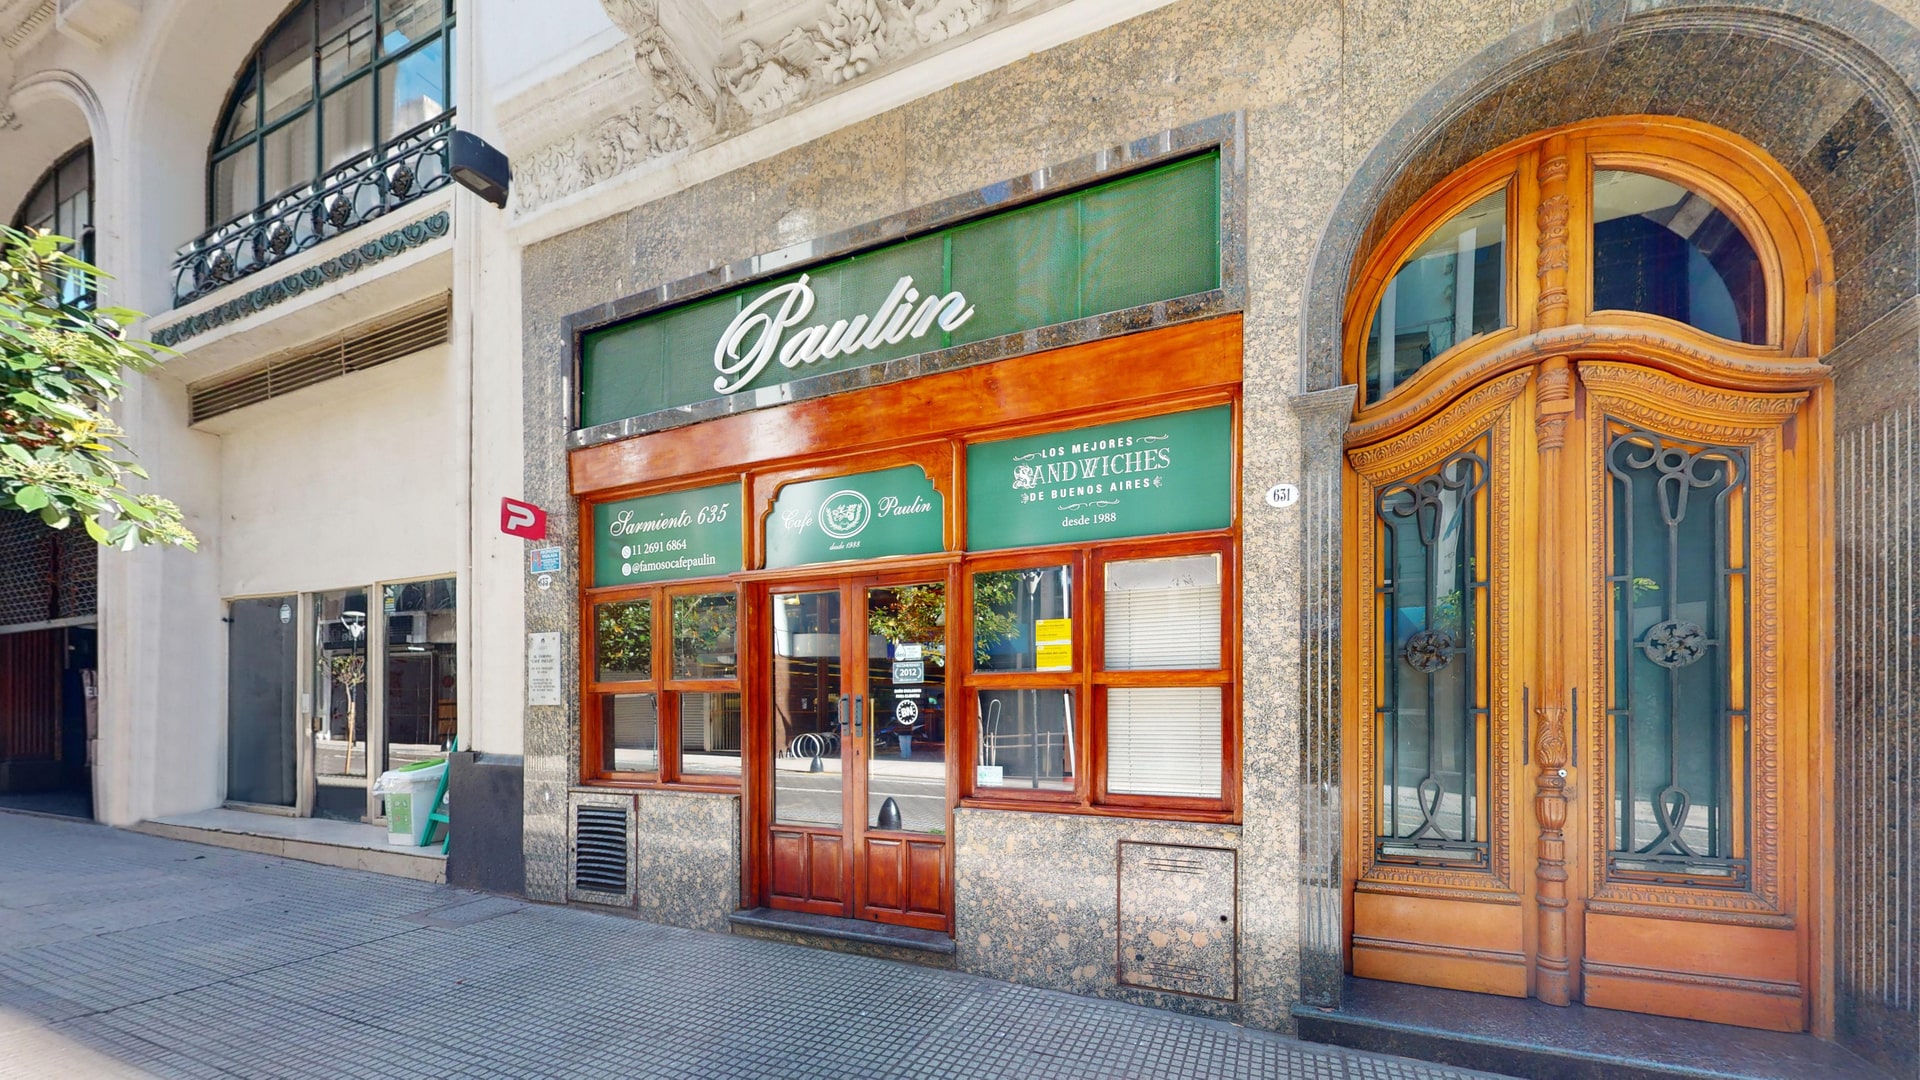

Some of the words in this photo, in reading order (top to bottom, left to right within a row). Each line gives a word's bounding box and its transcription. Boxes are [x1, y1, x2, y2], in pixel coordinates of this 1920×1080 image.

[713, 273, 976, 395] Paulin
[1041, 447, 1065, 459] LOS
[1072, 436, 1134, 454] MEJORES
[1012, 447, 1171, 490] SANDWICHES
[1029, 491, 1045, 502] DE
[1051, 485, 1103, 499] BUENOS
[1110, 478, 1150, 492] AIRES
[1273, 488, 1290, 502] 631
[609, 509, 693, 537] Sarmiento
[696, 502, 730, 525] 635
[781, 509, 813, 535] Cafe
[877, 495, 932, 518] Paulin
[1062, 515, 1090, 527] desde
[1093, 512, 1117, 524] 1988
[632, 544, 642, 556] 11
[644, 542, 664, 555] 2691
[666, 539, 687, 552] 6864
[829, 542, 845, 551] desde
[631, 553, 716, 574] @famosocafepaulin
[899, 668, 917, 677] 2012
